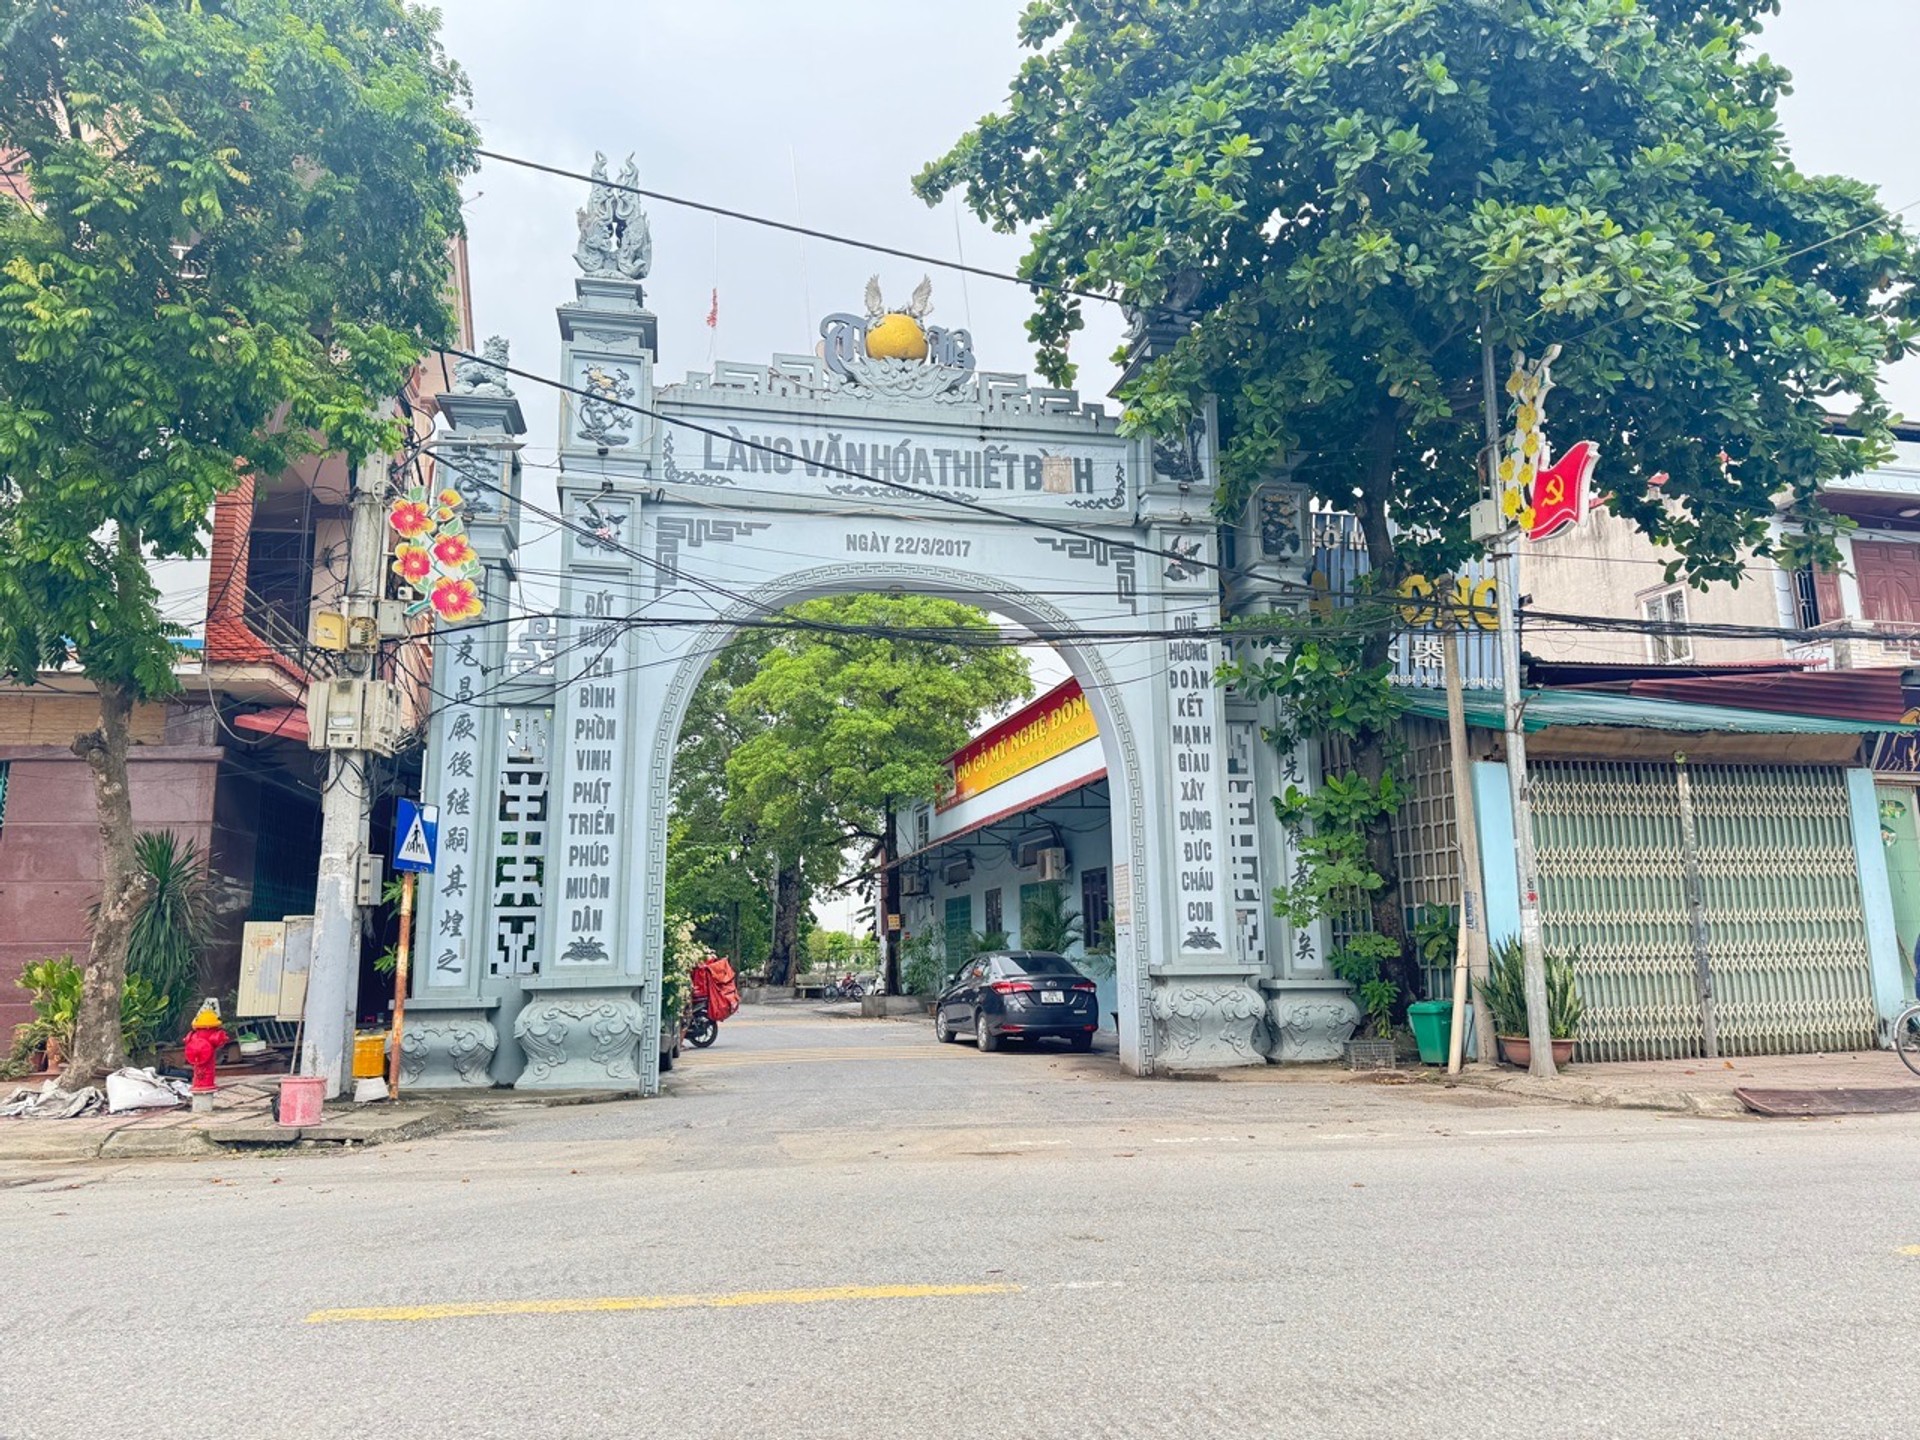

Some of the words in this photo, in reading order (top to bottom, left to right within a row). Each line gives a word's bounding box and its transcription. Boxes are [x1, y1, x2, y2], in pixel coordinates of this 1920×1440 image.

[703, 426, 794, 475] LÀNG
[800, 433, 867, 480] VĂN
[871, 438, 934, 486] HÓA
[1024, 448, 1094, 494] BH
[845, 531, 890, 553] NGÀY
[894, 536, 971, 558] 22/3/2017
[585, 589, 614, 616] ĐẤT
[583, 653, 614, 678] YÊN
[1169, 666, 1209, 689] ĐOÀN
[579, 683, 616, 709] BÌNH
[1178, 692, 1203, 717] KẾT
[1010, 711, 1049, 754] NGHỆ
[1172, 725, 1212, 748] MẠNH
[576, 749, 612, 771] VINH
[573, 777, 612, 804] PHÁT
[1181, 778, 1205, 801] XÂY
[568, 805, 615, 835] TRIỂN
[1180, 808, 1212, 835] DỰNG
[568, 841, 610, 867] PHÚC
[565, 873, 611, 900] MUÔN
[1182, 866, 1214, 892] CHÁU
[571, 905, 603, 932] DÂN
[1187, 902, 1214, 922] CON
